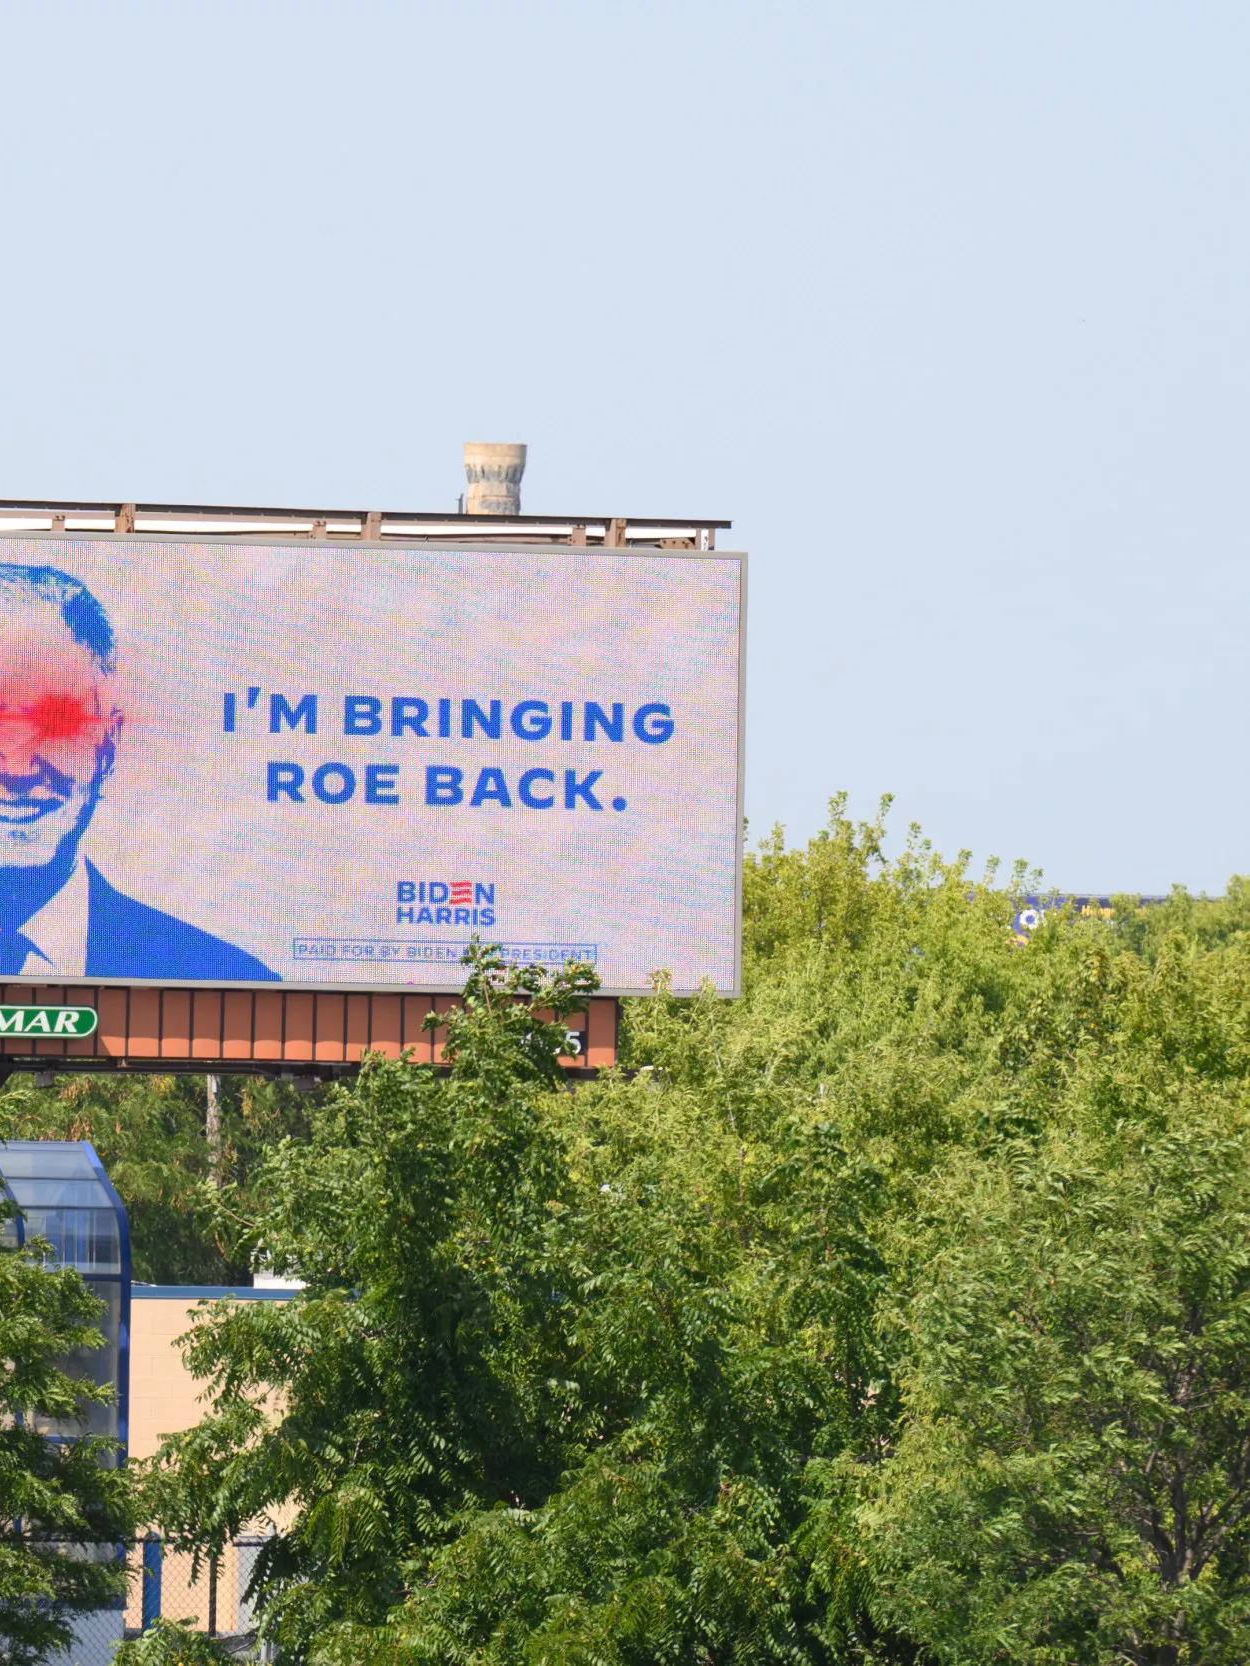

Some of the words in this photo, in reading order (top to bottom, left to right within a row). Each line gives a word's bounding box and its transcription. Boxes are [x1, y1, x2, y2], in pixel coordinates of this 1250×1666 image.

[223, 687, 318, 734] I'M
[344, 695, 675, 744] BRINGING
[267, 762, 400, 805] ROE
[425, 765, 628, 812] BACK.
[397, 880, 495, 905] BIDEN
[397, 906, 496, 927] HARRIS
[298, 944, 336, 956] PAID
[343, 945, 375, 957] FOR
[381, 945, 401, 958] BY
[407, 946, 457, 959] BIDEN
[501, 948, 591, 961] PRESIDENT
